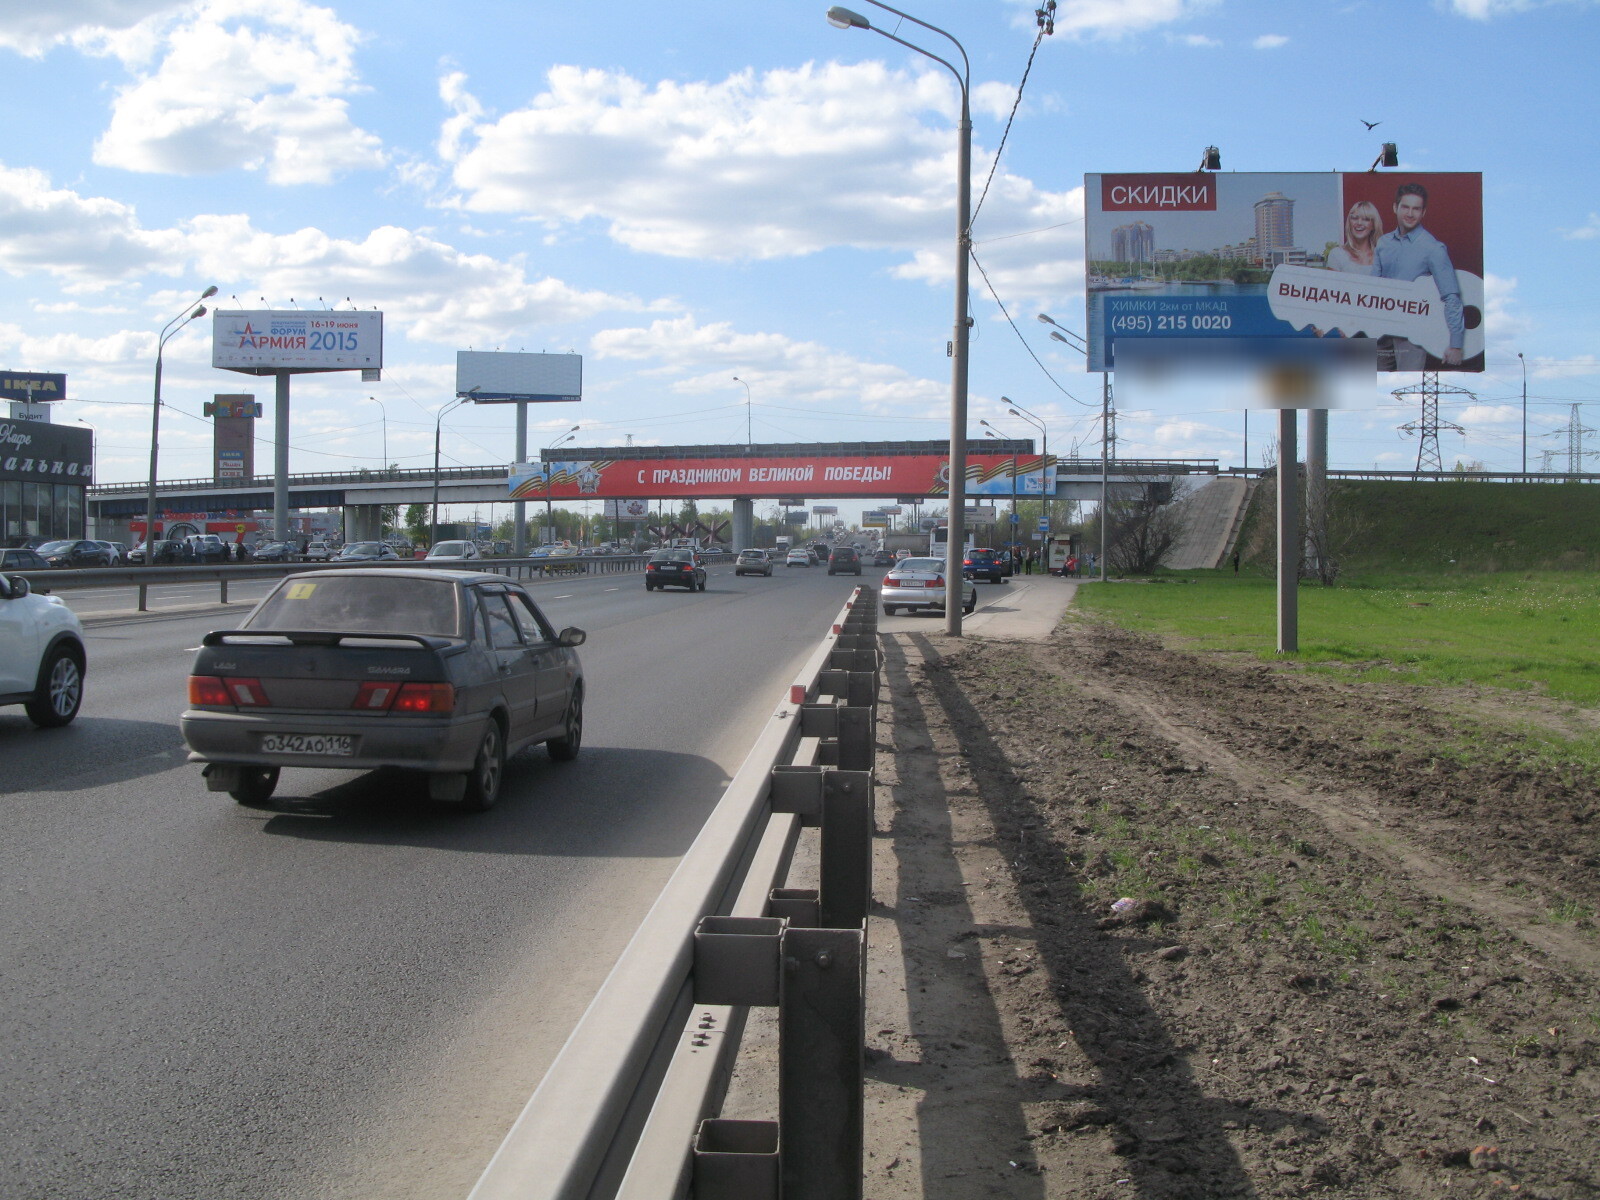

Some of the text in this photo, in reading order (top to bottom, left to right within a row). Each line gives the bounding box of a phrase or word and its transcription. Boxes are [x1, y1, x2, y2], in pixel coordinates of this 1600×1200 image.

[1111, 186, 1208, 207] СКИДКИ
[1112, 301, 1156, 311] ХИМКИ
[1196, 302, 1228, 312] МКАД
[1279, 283, 1430, 316] ВЫДАЧА КЛЮЧЕЙ
[1111, 315, 1232, 333] (495) 215 0020
[309, 331, 358, 350] 2015
[4, 379, 57, 391] IKEA
[0, 456, 92, 477] альная
[637, 465, 892, 486] С ПРАЗДНИКОМ ВЕЛИКОЙ ПОБЕДЫ!
